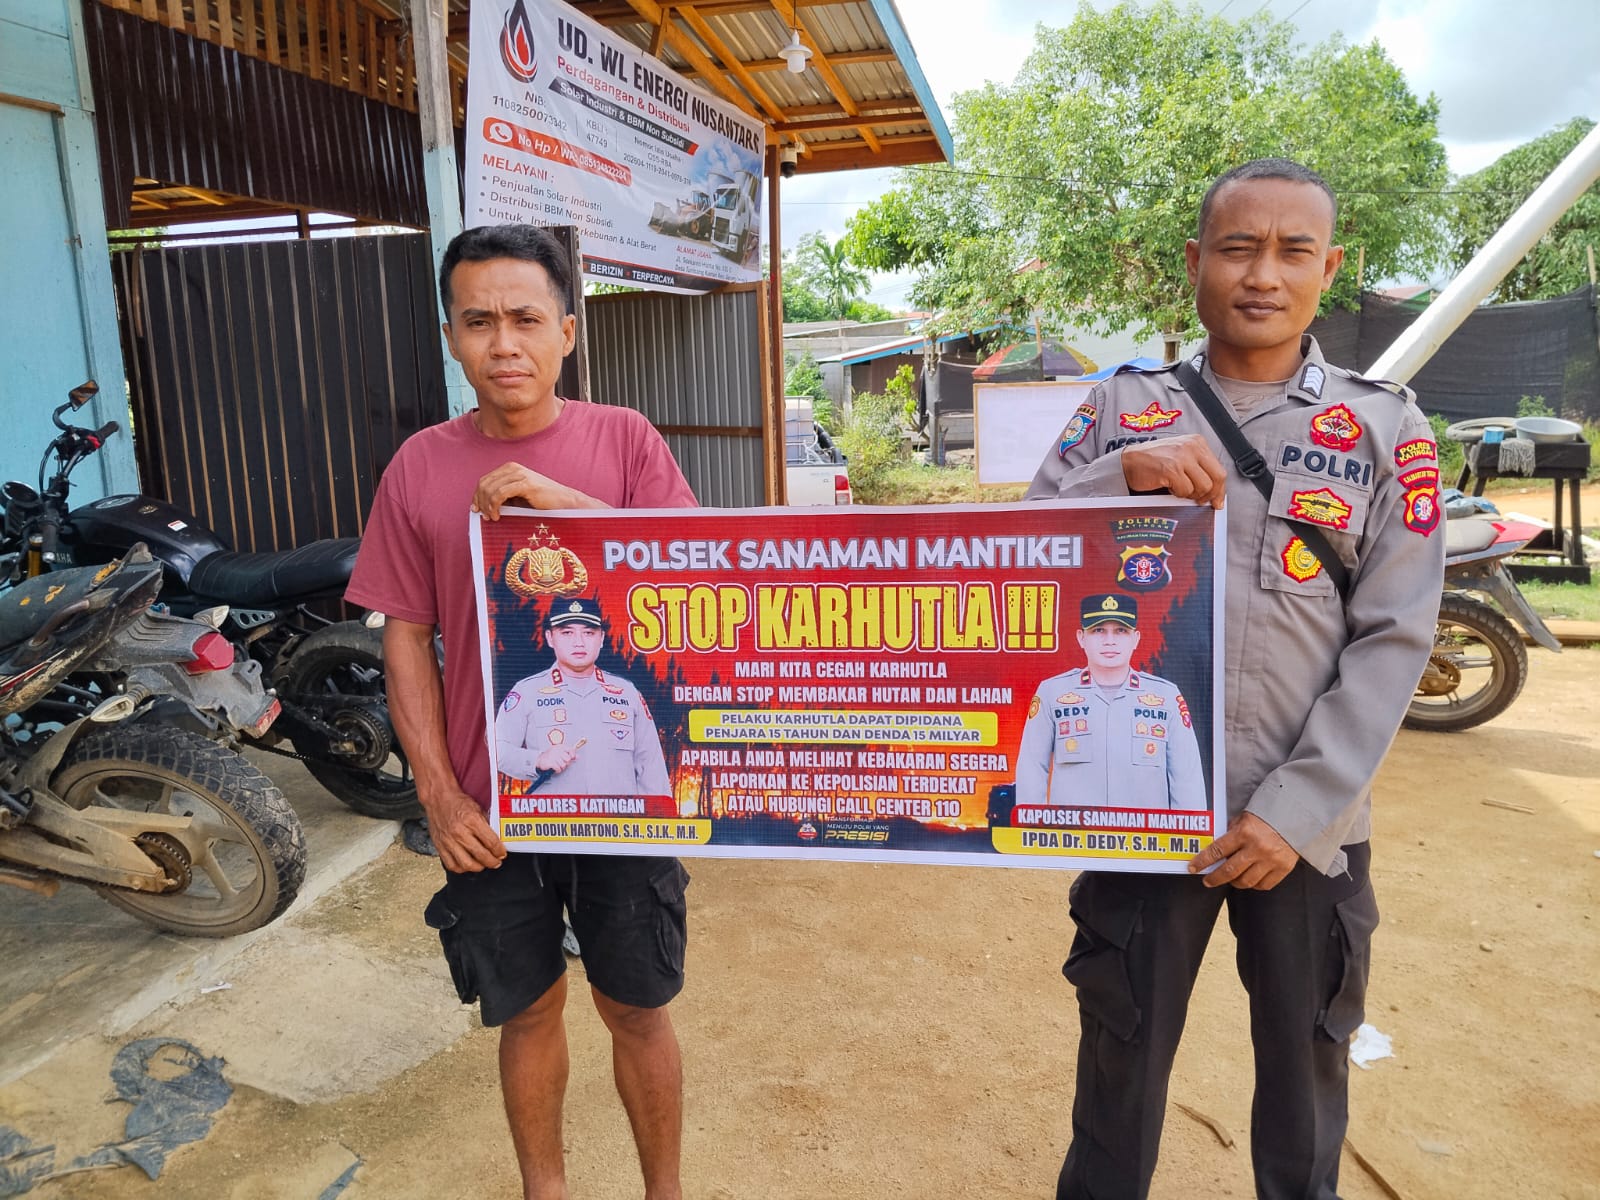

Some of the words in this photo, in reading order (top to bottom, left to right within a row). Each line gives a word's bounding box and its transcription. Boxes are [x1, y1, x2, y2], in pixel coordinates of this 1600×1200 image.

[558, 18, 593, 64] UD.
[601, 42, 627, 83] WL
[634, 62, 688, 115] ENERGI
[525, 91, 546, 107] NIB:
[557, 55, 634, 105] Perdagangan
[637, 97, 645, 110] &
[648, 102, 690, 132] Distribusi
[560, 82, 585, 101] Solar
[586, 92, 617, 118] Industri
[618, 109, 626, 121] &
[627, 115, 645, 131] BBM
[646, 123, 660, 138] Non
[661, 129, 684, 149] Subsidi
[518, 134, 532, 147] No
[535, 139, 550, 154] Hp
[587, 133, 607, 148] 47749
[482, 154, 547, 181] MELAYANI
[492, 175, 545, 197] Penjualan
[546, 189, 568, 203] Solar
[570, 194, 602, 212] Industri
[490, 191, 543, 212] Distribusi
[544, 201, 564, 217] BBM
[565, 210, 583, 221] Non
[585, 214, 613, 229] Subsidi
[488, 207, 523, 222] Untuk
[580, 228, 617, 242] rkebunan
[619, 236, 625, 244] &
[627, 237, 639, 247] Alat
[641, 241, 656, 252] Berat
[590, 263, 624, 277] BERIZIN
[632, 270, 675, 286] TERPERCAYA
[1282, 445, 1371, 486] POLRI
[1118, 517, 1168, 526] POLRES
[602, 540, 732, 570] POLSEK
[739, 538, 908, 570] SANAMAN
[917, 536, 1082, 568] MANTIKEI
[630, 585, 749, 651] STOP
[757, 585, 998, 651] KARHUTLA
[1006, 585, 1056, 649] !!!
[735, 661, 774, 678] MARI
[779, 661, 812, 678] KITA
[816, 661, 865, 678] CEGAH
[870, 662, 947, 679] KARHUTLA
[537, 698, 565, 707] DODIK
[602, 696, 630, 706] POLRI
[674, 686, 732, 702] DENGAN
[736, 686, 774, 702] STOP
[778, 686, 867, 703] MEMBAKAR
[872, 687, 921, 703] HUTAN
[925, 687, 957, 704] DAN
[962, 687, 1012, 704] LAHAN
[722, 714, 772, 724] PELAKU
[775, 714, 845, 725] KARHUTLA
[849, 715, 893, 725] DAPAT
[895, 715, 962, 727] DIPIDANA
[1054, 706, 1090, 719] DEDY
[1134, 708, 1167, 721] POLRI
[706, 728, 766, 738] PENJARA
[769, 729, 781, 739] 15
[783, 728, 829, 739] TAHUN
[832, 729, 861, 739] DAN
[864, 730, 911, 740] DENDA
[913, 731, 926, 741] 15
[929, 731, 980, 742] MILYAR
[681, 750, 741, 766] APABILA
[745, 751, 785, 767] ANDA
[789, 751, 853, 768] MELIHAT
[857, 752, 945, 770] KEBAKARAN
[950, 754, 1008, 771] SEGERA
[711, 773, 787, 790] LAPORKAN
[791, 773, 810, 790] KE
[813, 774, 898, 792] KEPOLISIAN
[902, 776, 977, 794] TERDEKAT
[511, 798, 578, 814] KAPOLRES
[580, 798, 645, 814] KATINGAN
[728, 795, 764, 812] ATAU
[768, 796, 832, 813] HUBUNGI
[835, 797, 872, 814] CALL
[876, 799, 931, 816] CENTER
[935, 800, 961, 817] 110
[1018, 808, 1081, 826] KAPOLSEK
[1083, 810, 1145, 828] SANAMAN
[1149, 813, 1210, 831] MANTIKEI
[505, 823, 533, 837] AKBP
[535, 823, 568, 837] DODIK
[676, 826, 699, 840] M.H.
[824, 830, 890, 841] PRESISI
[1022, 831, 1059, 848] IPDA
[1063, 834, 1083, 849] Dr.
[1087, 834, 1129, 852] DEDY,
[1133, 836, 1166, 852] S.H.,
[1170, 837, 1199, 854] M.H
